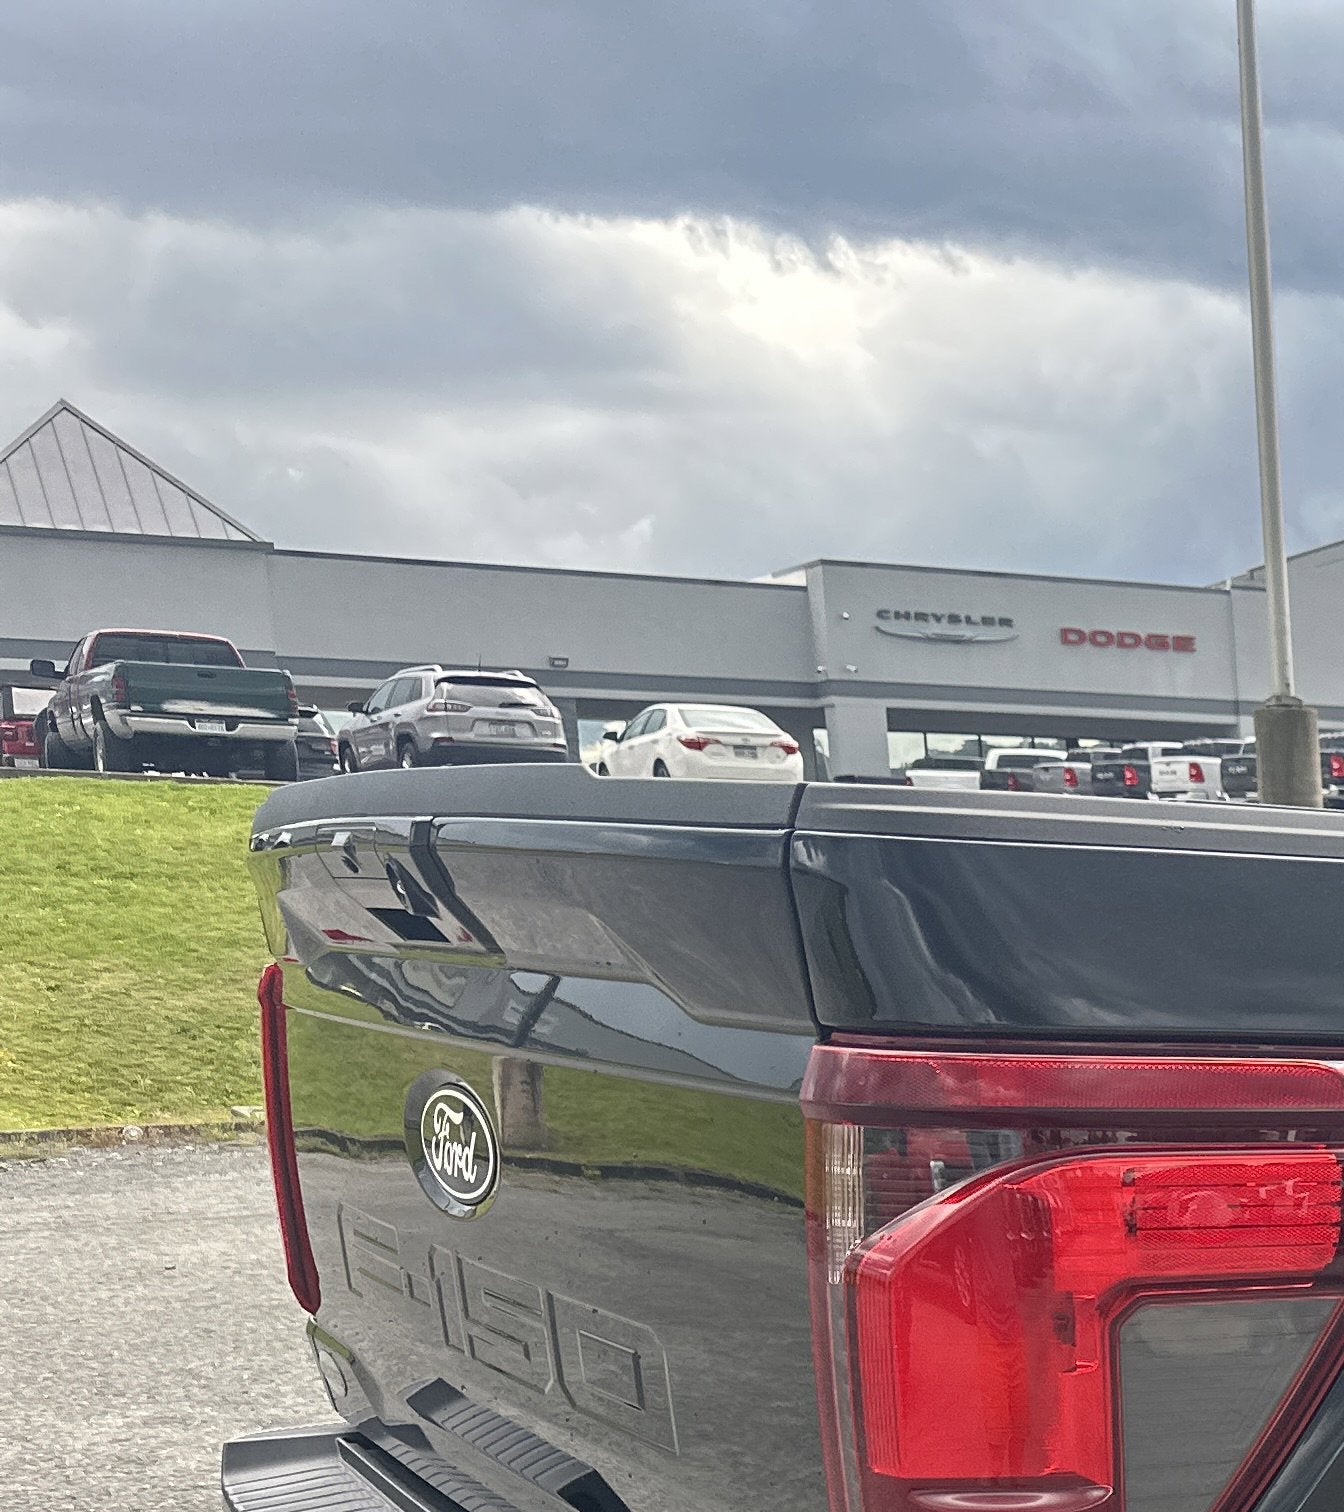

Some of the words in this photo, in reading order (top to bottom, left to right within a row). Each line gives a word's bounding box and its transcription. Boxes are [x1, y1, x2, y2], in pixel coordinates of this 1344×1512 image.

[876, 607, 1015, 629] CHRYSLER
[1060, 627, 1198, 653] DODGE
[432, 1102, 477, 1184] Ford
